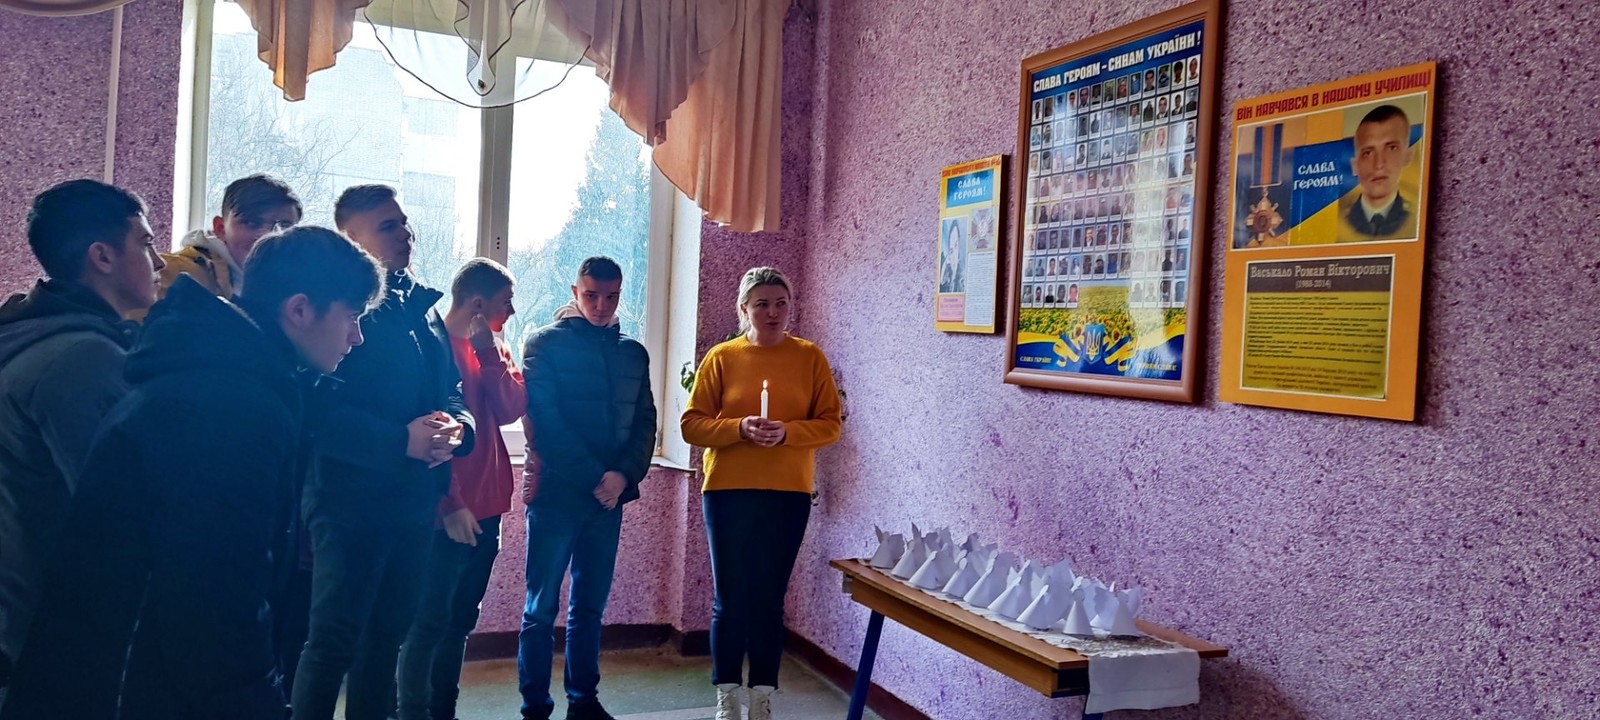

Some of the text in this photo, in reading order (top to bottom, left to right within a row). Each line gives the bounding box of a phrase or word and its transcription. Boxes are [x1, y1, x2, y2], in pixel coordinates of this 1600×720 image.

[1033, 74, 1062, 93] СЛАВА
[1063, 62, 1101, 84] ГЕРОЯМ
[1108, 49, 1144, 72] СИНАМ
[1236, 69, 1431, 121] ВІН НАВЧАВСЯ В НАШОМУ УЧИЛИЩІ
[1298, 161, 1335, 175] СЛАВА
[957, 176, 981, 189] СЛАВА
[1293, 174, 1344, 190] ГЕРОЯМ!
[953, 186, 986, 201] ГЕРОЯМ!
[1294, 265, 1326, 277] Роман
[1328, 263, 1390, 279] Вікторович
